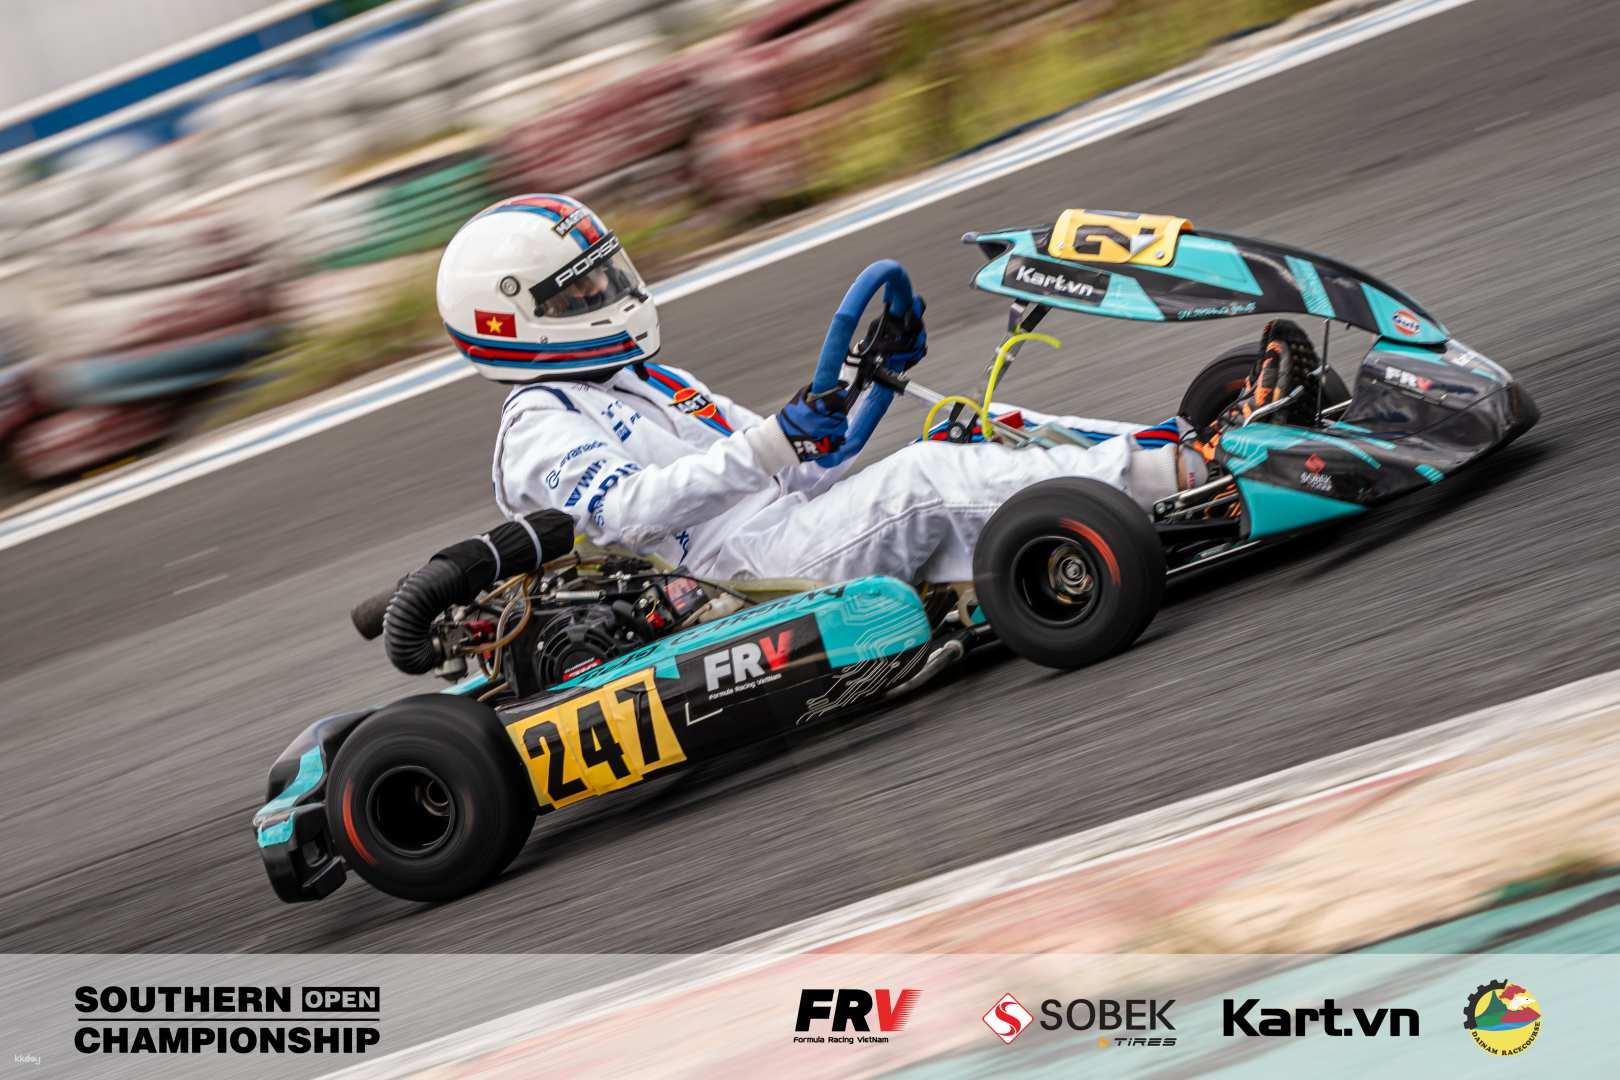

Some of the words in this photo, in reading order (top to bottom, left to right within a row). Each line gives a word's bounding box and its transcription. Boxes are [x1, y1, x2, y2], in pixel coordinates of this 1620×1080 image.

[1015, 264, 1094, 297] Kart.vn
[1385, 366, 1433, 391] FRV
[703, 629, 794, 692] FRV
[524, 680, 662, 801] 247
